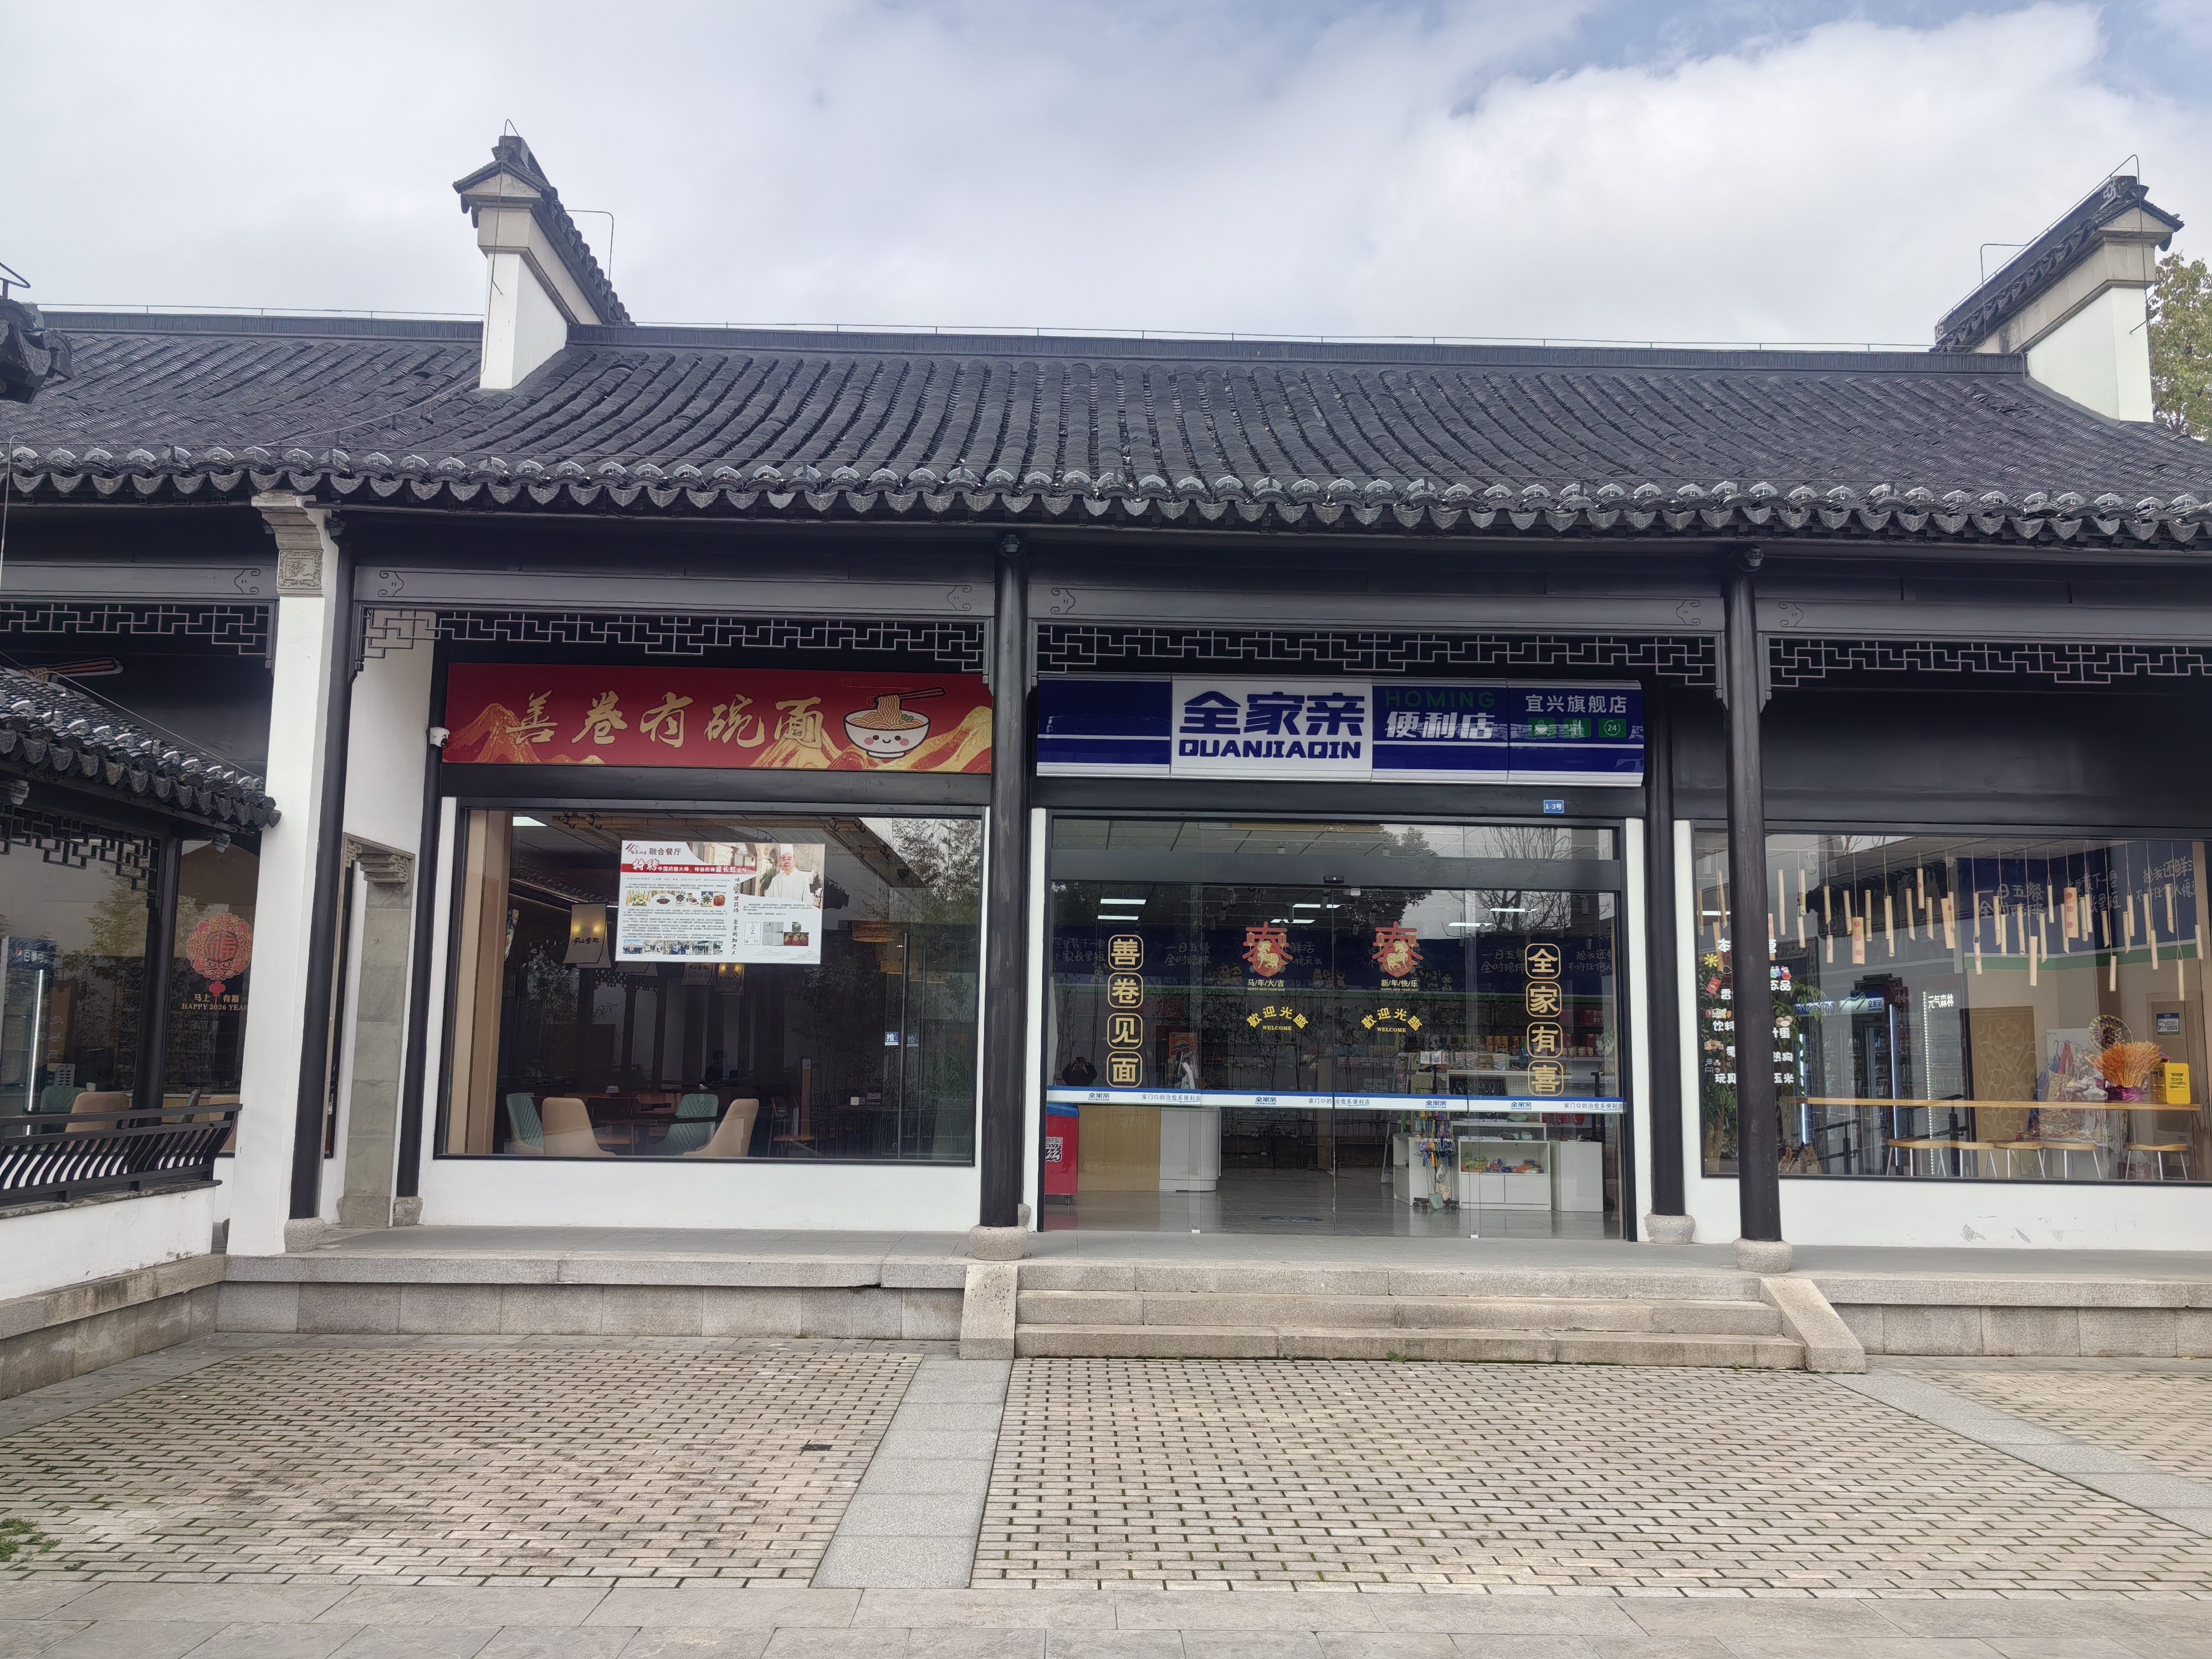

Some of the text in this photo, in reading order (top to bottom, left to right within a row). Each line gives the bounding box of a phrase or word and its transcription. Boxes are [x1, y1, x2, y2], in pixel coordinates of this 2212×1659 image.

[1386, 690, 1495, 708] HOMING
[1526, 694, 1627, 713] 宜兴旗舰店
[505, 690, 824, 748] 善卷有碗面
[1179, 691, 1365, 736] 全家亲
[1386, 711, 1495, 739] 便利店
[1179, 739, 1361, 759] QUANJIAQIN
[632, 858, 660, 871] 特聘
[1111, 939, 1141, 1083] 善卷见面
[1928, 994, 1954, 1009] 元气森林
[1246, 1005, 1309, 1029] 歡迎光臨
[1361, 1007, 1422, 1031] 歡迎光臨
[1527, 948, 1561, 1093] 全家有喜
[886, 1033, 895, 1042] 推
[907, 1035, 915, 1043] 拉
[1715, 1073, 1736, 1084] 玩具
[1774, 1073, 1794, 1084] 玉米
